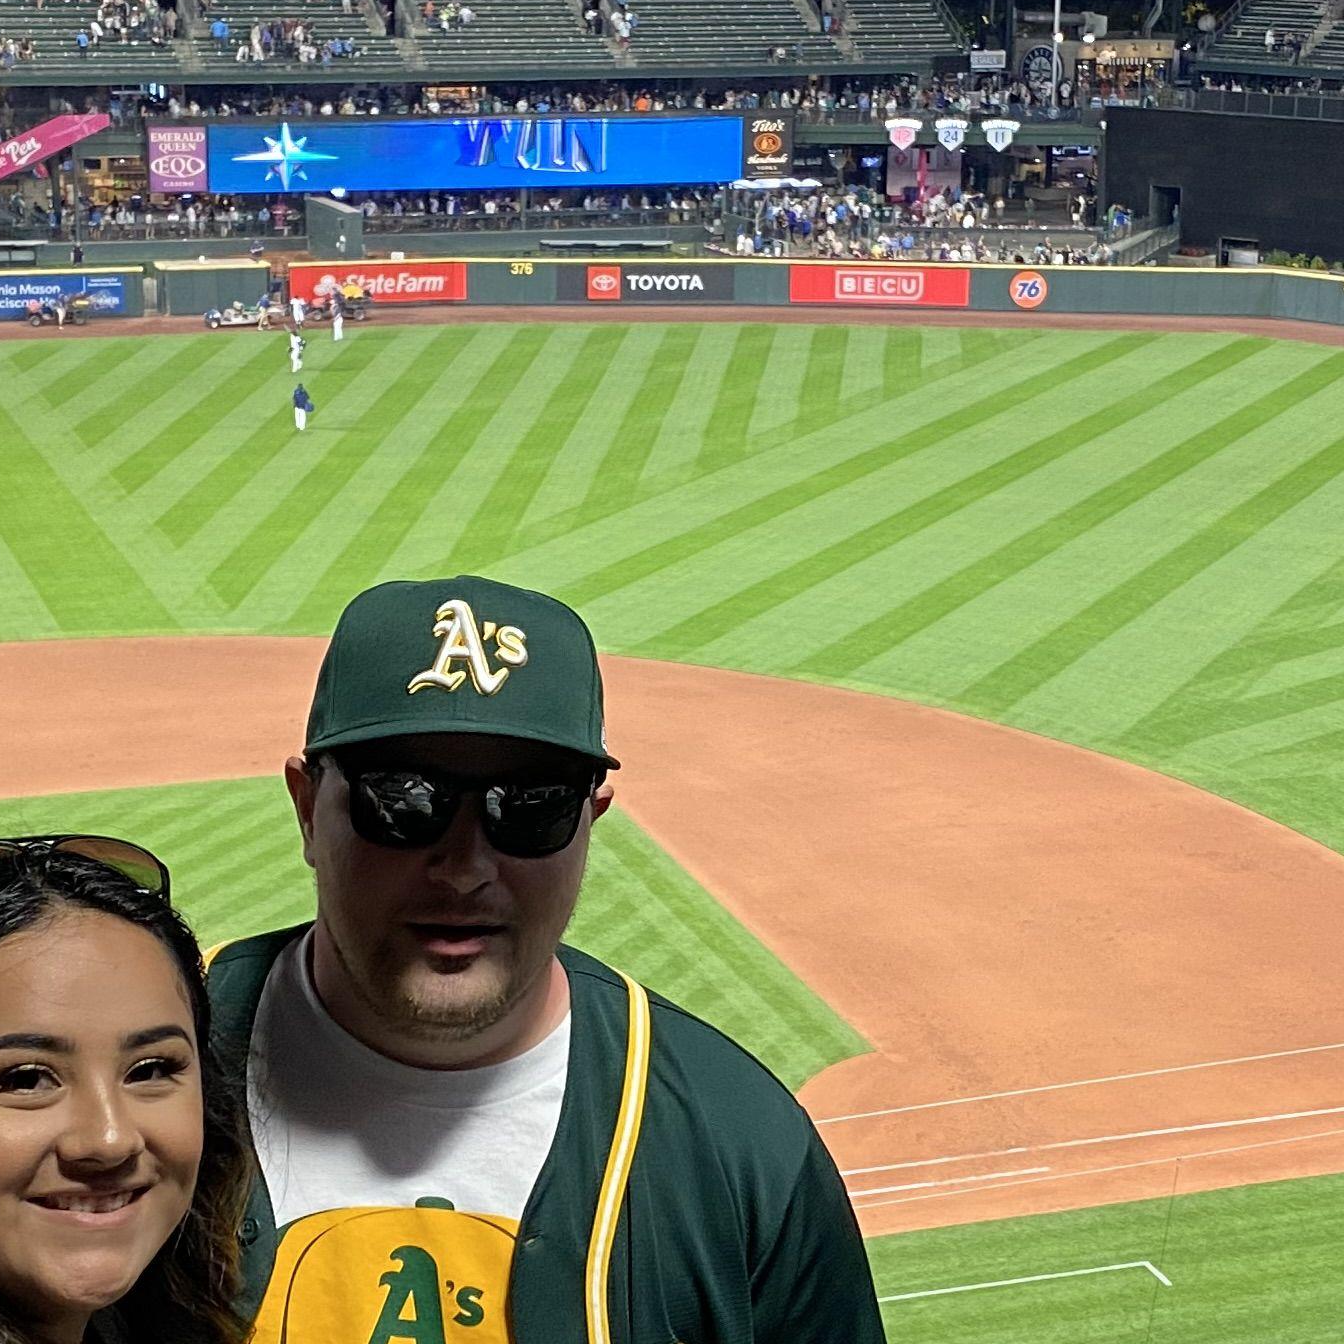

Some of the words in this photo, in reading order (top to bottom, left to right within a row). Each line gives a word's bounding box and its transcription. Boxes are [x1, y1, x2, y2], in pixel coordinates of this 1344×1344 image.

[150, 132, 205, 143] EMERALD
[943, 129, 959, 143] 24
[158, 143, 197, 154] QUEEN
[510, 262, 533, 276] 376
[19, 283, 61, 295] Mason
[625, 274, 704, 292] TOYOTA
[1016, 280, 1040, 297] 76
[407, 599, 529, 697] A's
